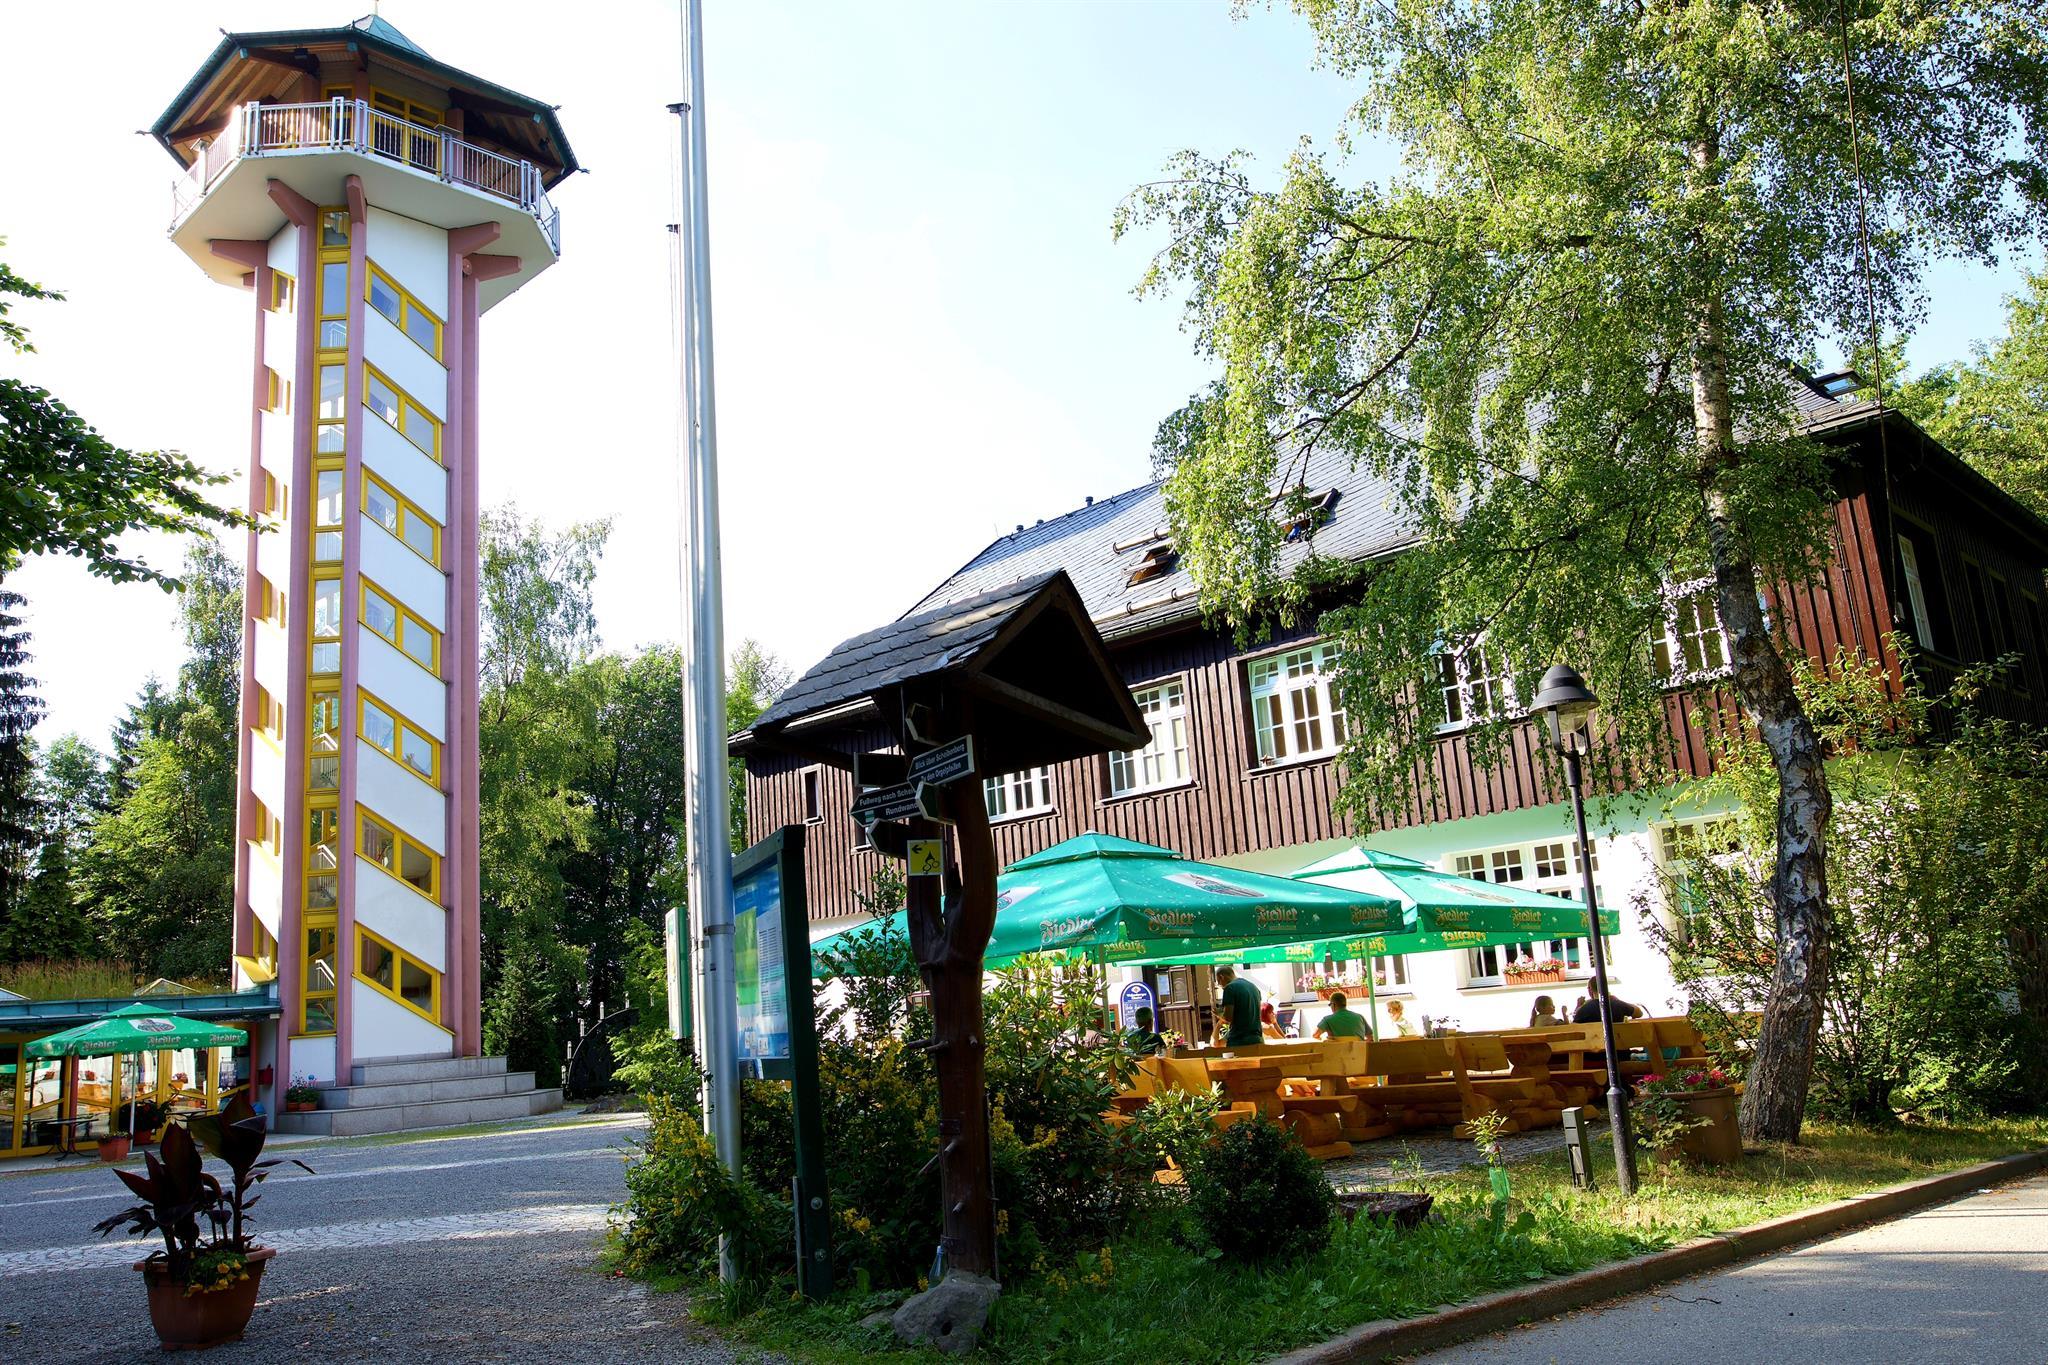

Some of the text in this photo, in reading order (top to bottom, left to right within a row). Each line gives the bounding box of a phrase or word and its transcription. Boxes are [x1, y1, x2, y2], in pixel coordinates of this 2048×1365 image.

[882, 791, 896, 802] nach
[1144, 908, 1195, 931] Fiedler
[1255, 905, 1298, 928] Fiedler
[1434, 907, 1470, 928] Fiedler
[1511, 907, 1542, 927] Fiedler
[1040, 914, 1096, 944] Fiedler
[82, 1040, 118, 1052] Fiedler
[147, 1036, 181, 1048] Fiedler
[209, 1033, 242, 1045] Fiedler
